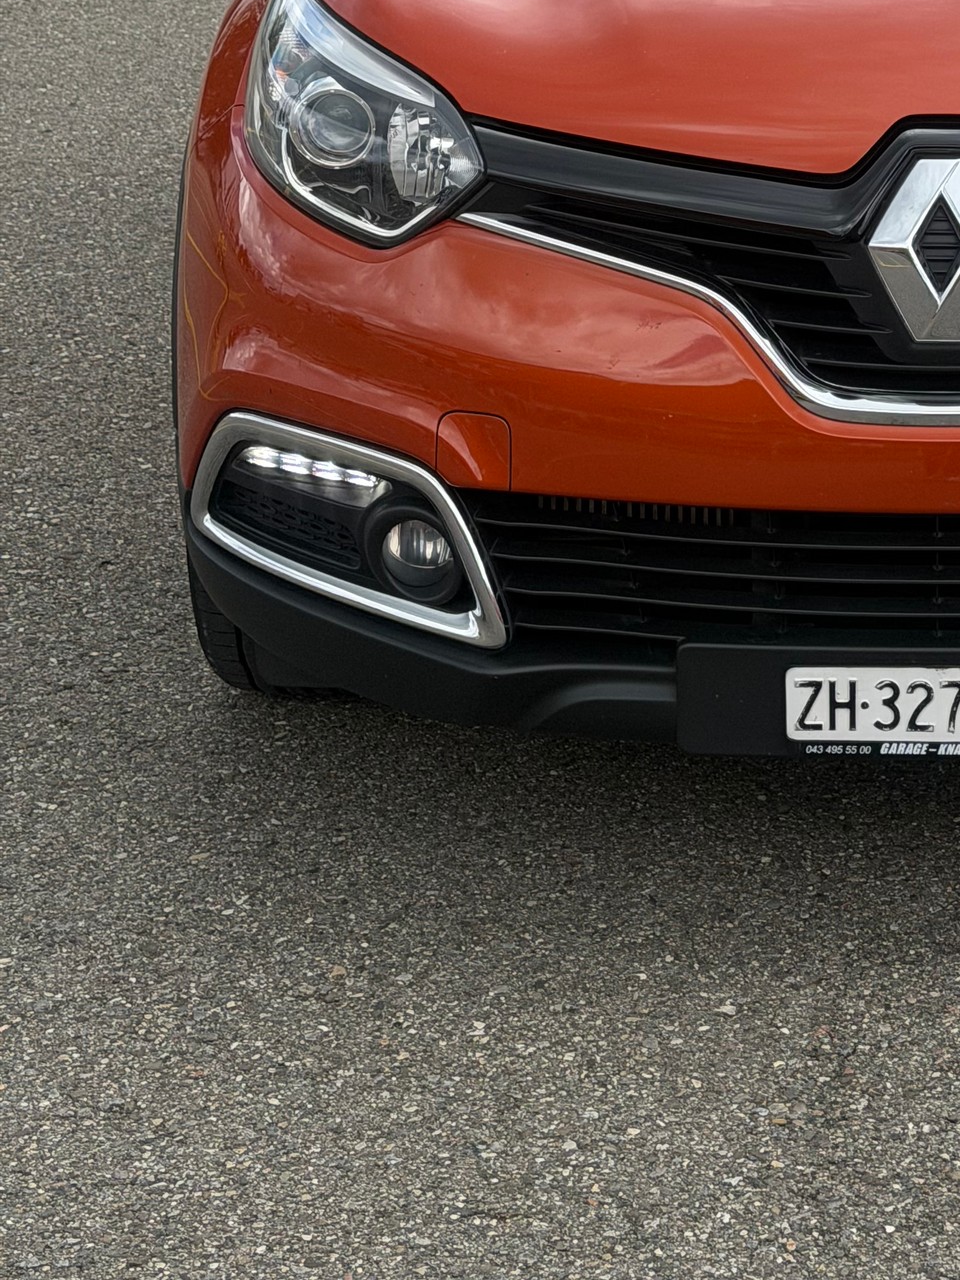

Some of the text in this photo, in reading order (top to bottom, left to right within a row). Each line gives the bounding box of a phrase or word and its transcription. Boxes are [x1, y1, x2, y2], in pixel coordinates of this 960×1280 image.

[805, 744, 823, 754] 043
[825, 744, 843, 755] 495
[844, 744, 858, 755] 55
[859, 744, 872, 755] 00
